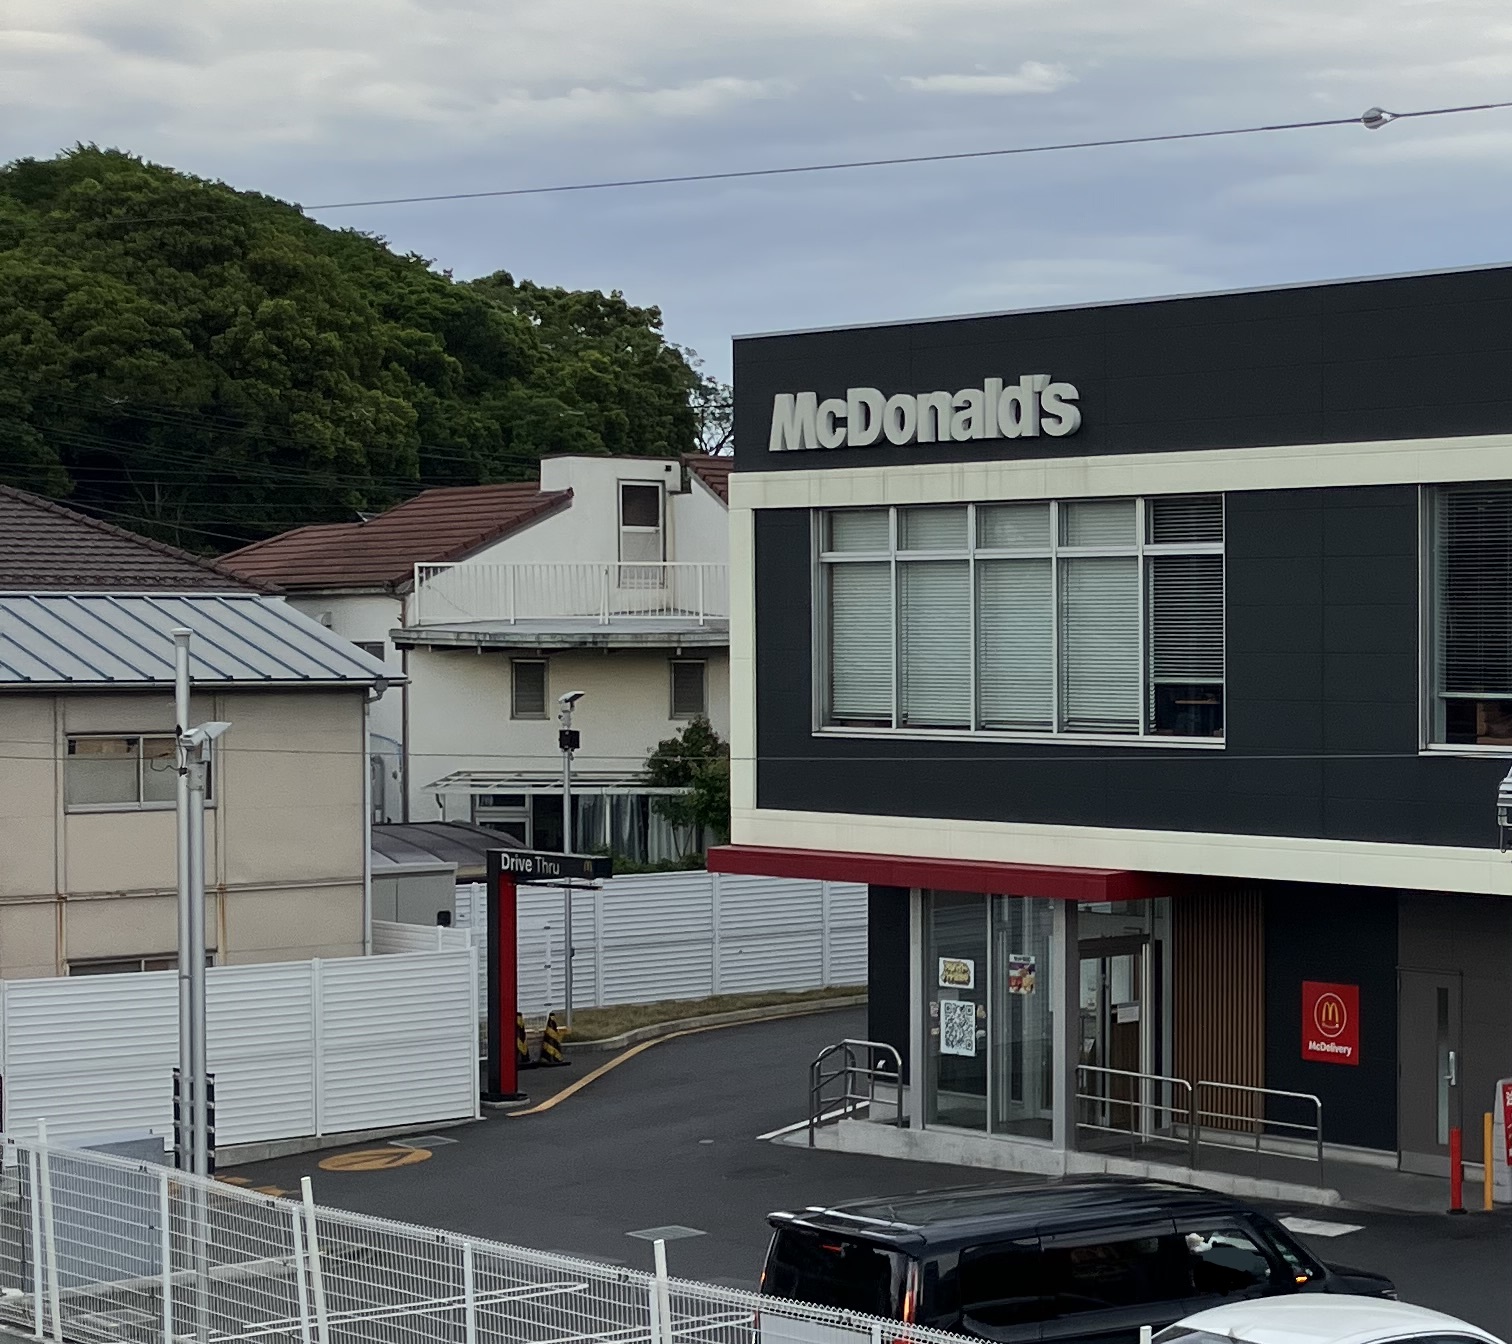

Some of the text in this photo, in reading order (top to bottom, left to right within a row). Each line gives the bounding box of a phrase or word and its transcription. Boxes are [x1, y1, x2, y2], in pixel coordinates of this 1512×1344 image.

[769, 373, 1082, 452] McDonald's
[501, 853, 560, 875] Drive Thru
[1308, 1040, 1352, 1057] McDelivery
